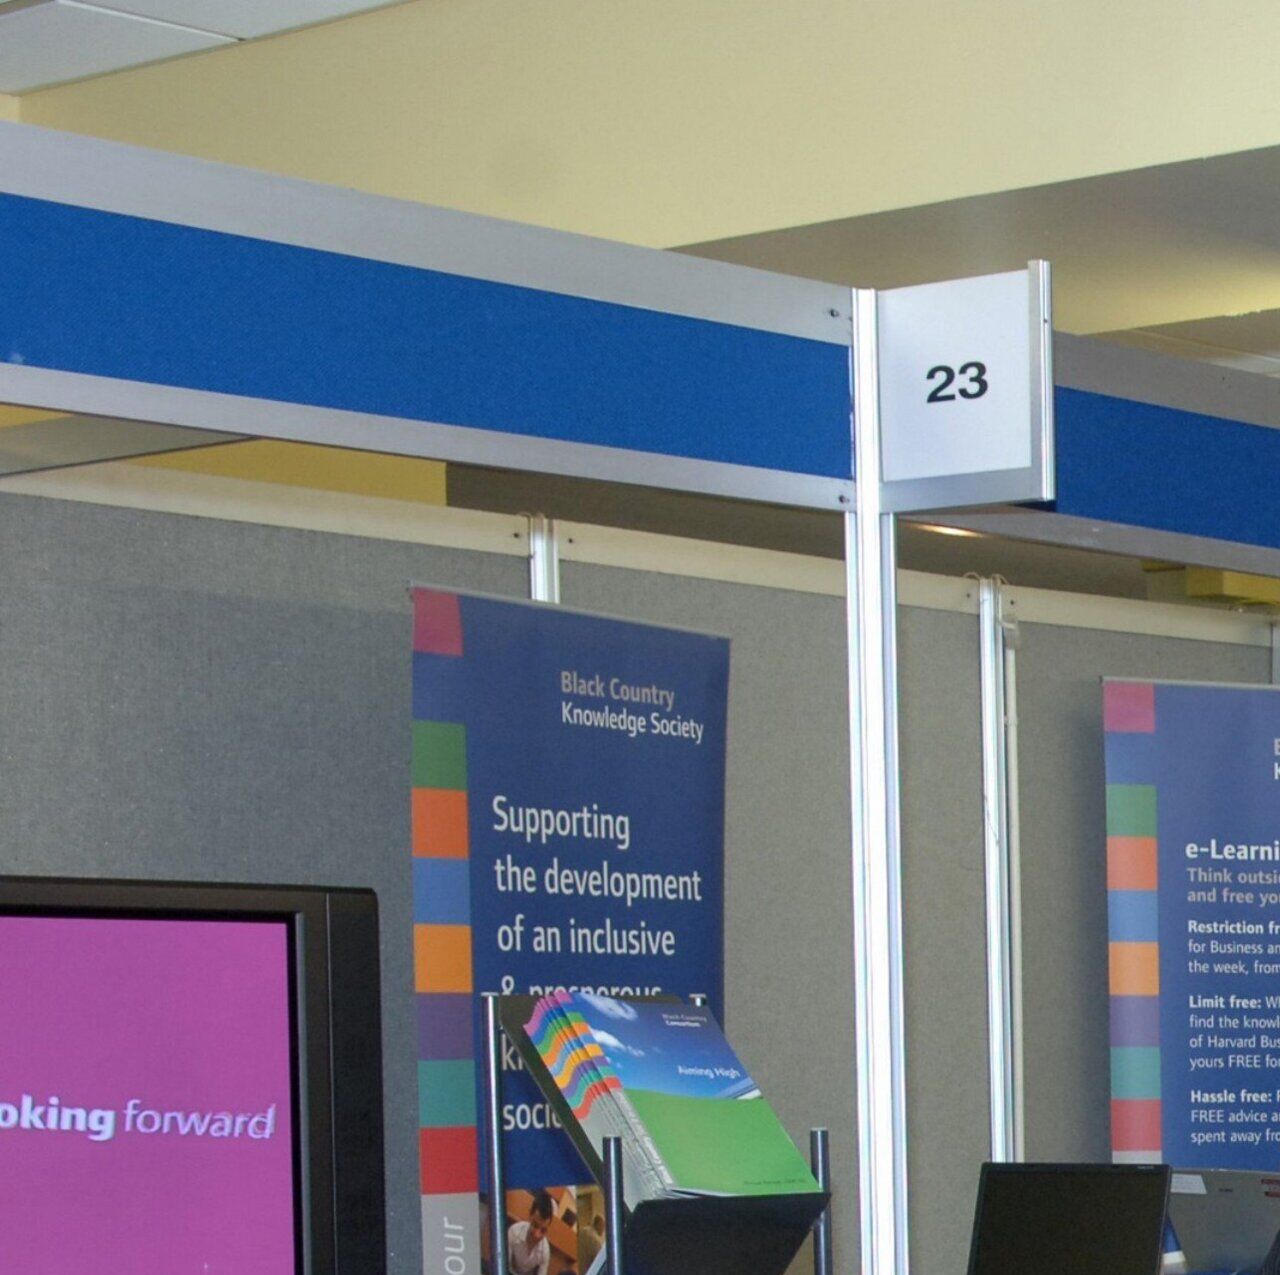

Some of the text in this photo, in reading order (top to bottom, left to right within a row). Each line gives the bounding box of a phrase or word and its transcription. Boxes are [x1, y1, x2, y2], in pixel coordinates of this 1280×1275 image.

[926, 361, 989, 404] 23
[560, 671, 675, 712] Black Country
[561, 702, 704, 744] Knowledge Society
[493, 796, 630, 850] Supporting
[495, 856, 702, 906] the development
[1187, 867, 1232, 883] Think
[1187, 888, 1217, 903] and
[1222, 888, 1254, 903] free
[1188, 920, 1264, 934] Restriction
[498, 914, 676, 956] of an inclusive
[1188, 940, 1206, 953] for
[1210, 940, 1263, 954] Business
[1188, 960, 1210, 973] the
[1213, 961, 1249, 975] week,
[1189, 995, 1226, 1009] Limit
[1230, 995, 1262, 1009] free:
[1189, 1016, 1215, 1028] find
[1219, 1016, 1239, 1028] the
[1189, 1035, 1203, 1048] of
[1207, 1035, 1257, 1049] Harvard
[1189, 1056, 1225, 1070] yours
[1228, 1055, 1261, 1068] FREE
[716, 1066, 741, 1079] High
[1190, 1090, 1272, 1103] Hassle free:
[124, 1099, 276, 1139] forward
[1191, 1110, 1224, 1123] FREE
[1228, 1110, 1268, 1123] advice
[1191, 1131, 1261, 1145] spent away
